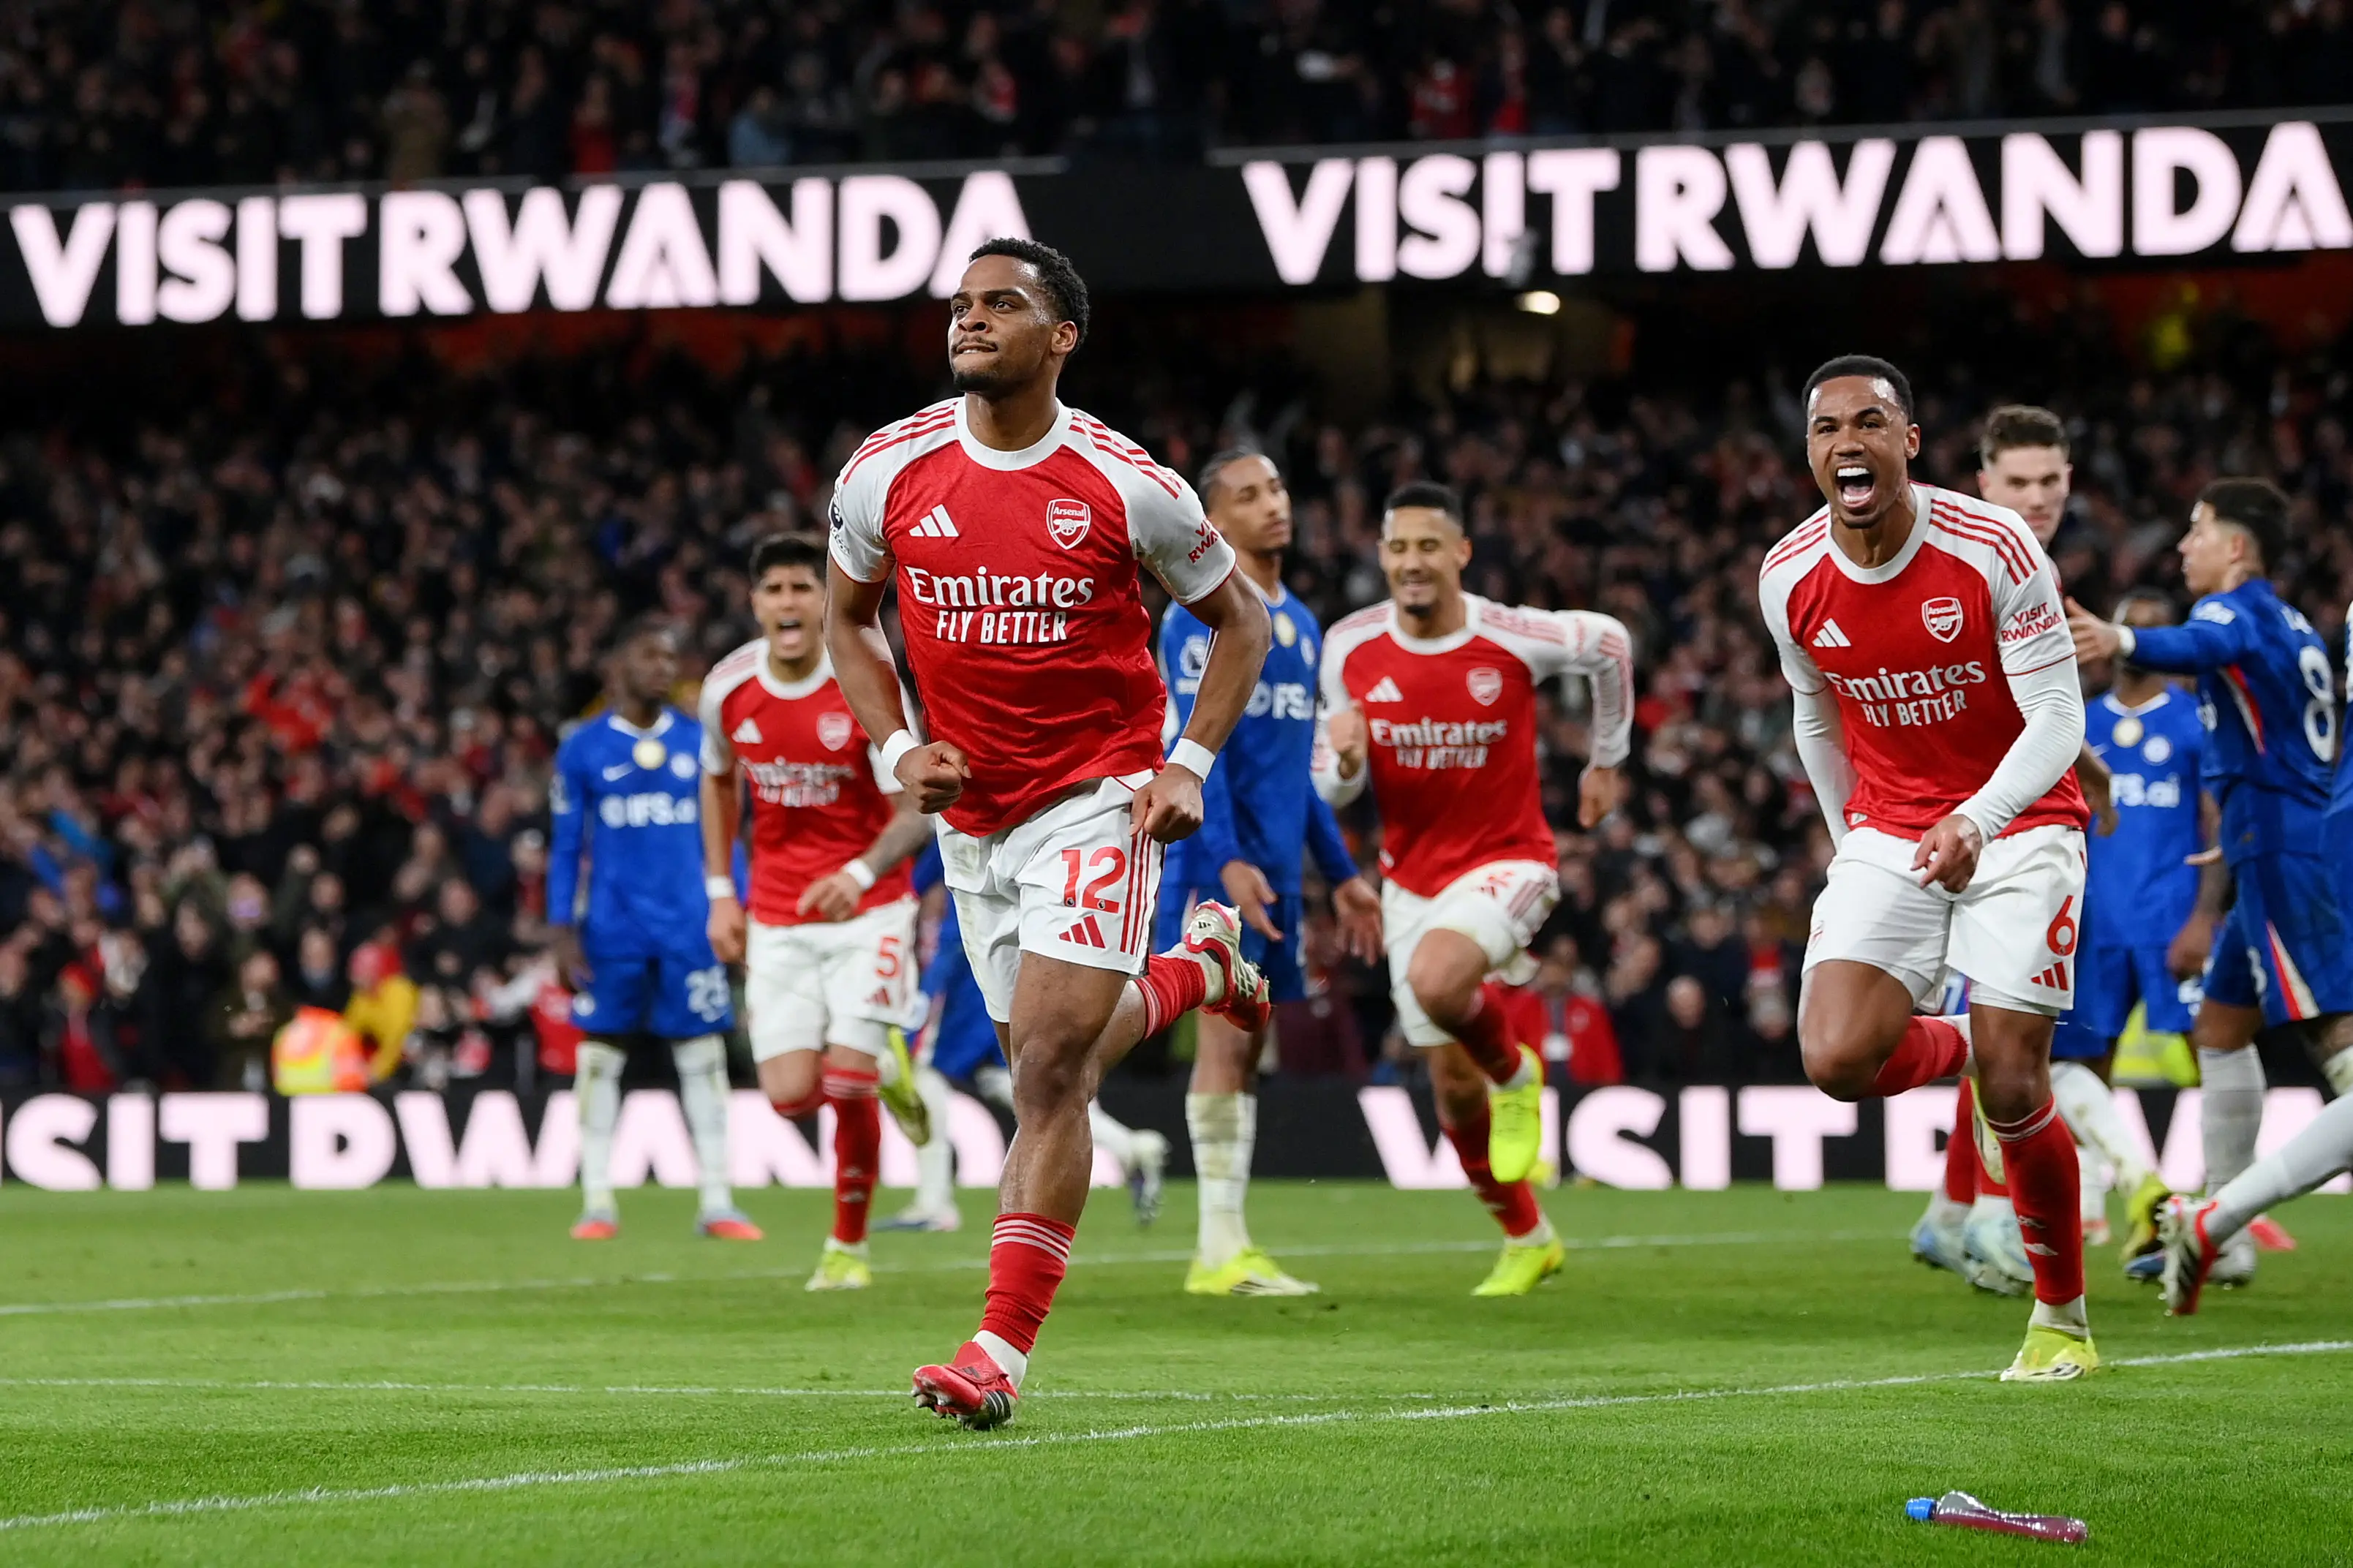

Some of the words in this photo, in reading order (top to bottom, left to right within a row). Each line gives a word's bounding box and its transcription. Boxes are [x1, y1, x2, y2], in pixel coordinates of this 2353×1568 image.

[1243, 148, 1622, 285] VISIT
[1635, 121, 2353, 273] RWANDA
[9, 192, 366, 328] VISIT
[379, 170, 1033, 316] RWANDA
[1053, 506, 1085, 517] Arsenal
[1188, 530, 1219, 564] RWA
[905, 566, 1094, 608] Emirates
[936, 610, 974, 643] FLY
[980, 611, 1067, 644] BETTER
[2001, 611, 2063, 642] RWANDA
[2013, 603, 2048, 625] VISIT
[1825, 661, 1987, 701] Emirates
[1896, 690, 1968, 726] BETTER
[2299, 645, 2337, 762] 8
[1061, 846, 1126, 913] 12
[2047, 894, 2077, 957] 6
[875, 936, 902, 979] 5
[0, 1091, 269, 1191] SIT
[290, 1090, 1126, 1191] RWAND
